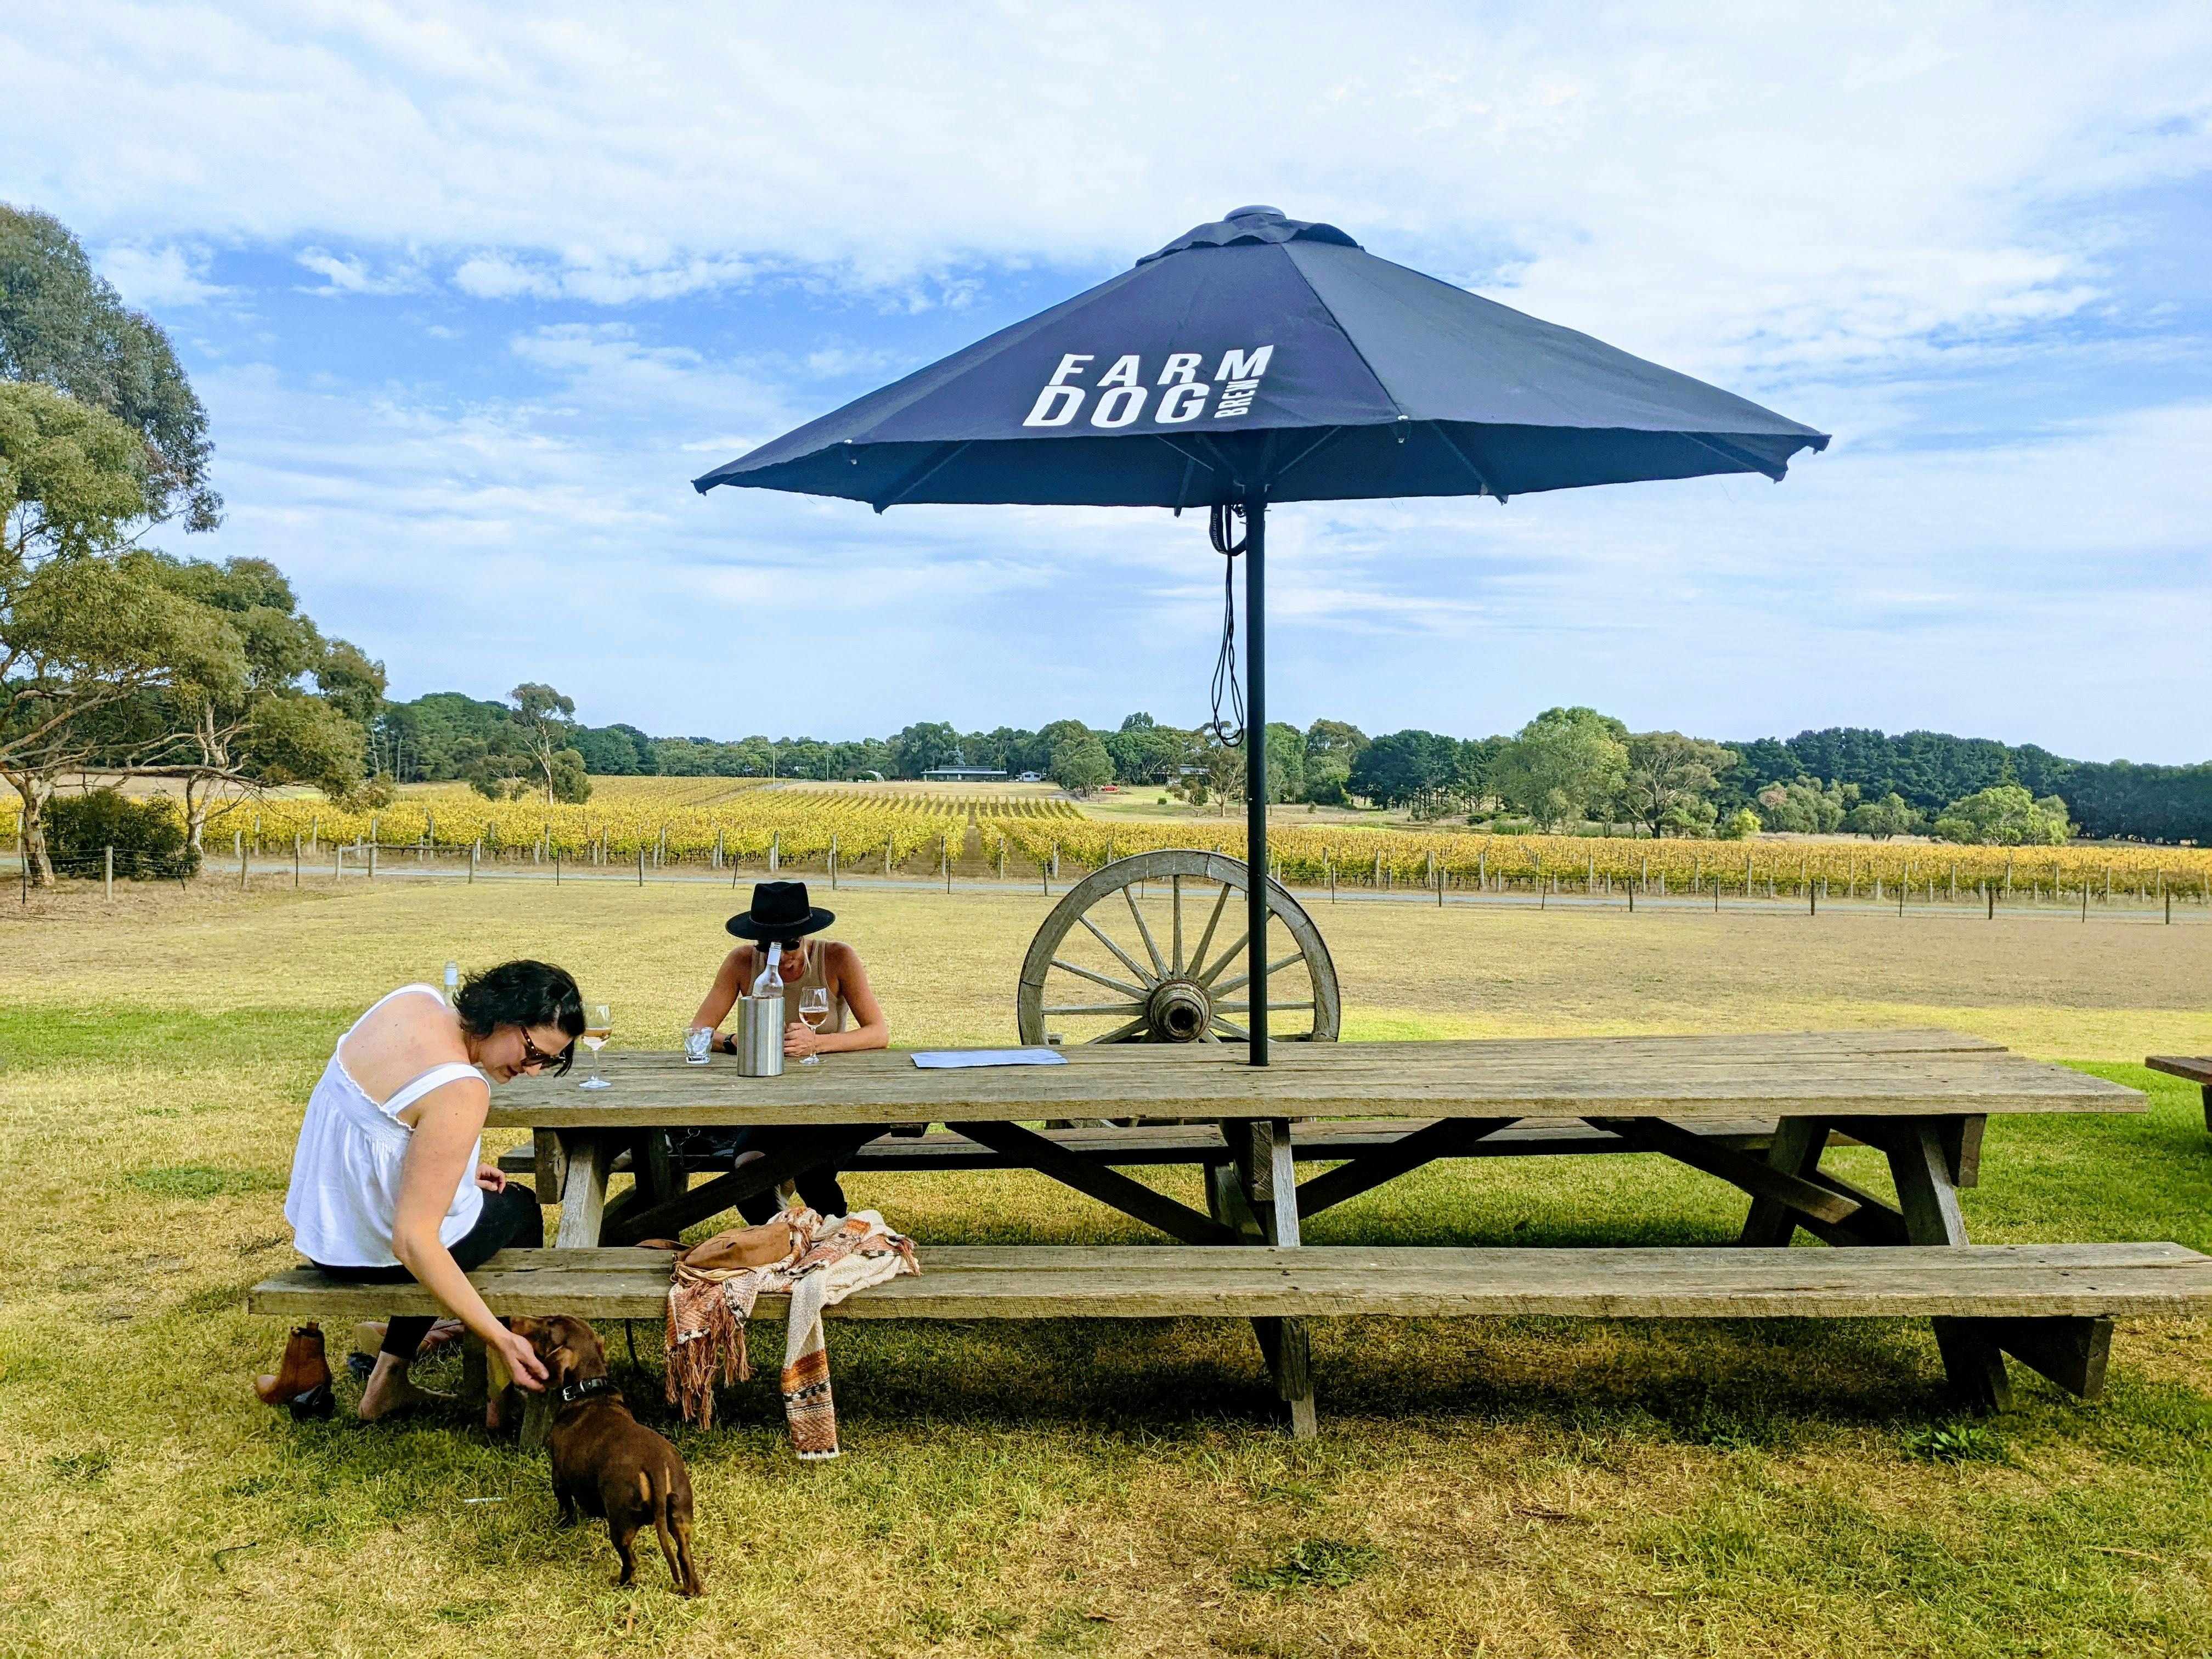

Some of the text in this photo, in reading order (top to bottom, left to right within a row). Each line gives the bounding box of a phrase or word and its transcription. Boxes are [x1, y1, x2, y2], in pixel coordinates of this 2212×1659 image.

[1048, 345, 1274, 386] FARM
[1022, 383, 1210, 428] DOG
[1214, 379, 1260, 418] BREW
